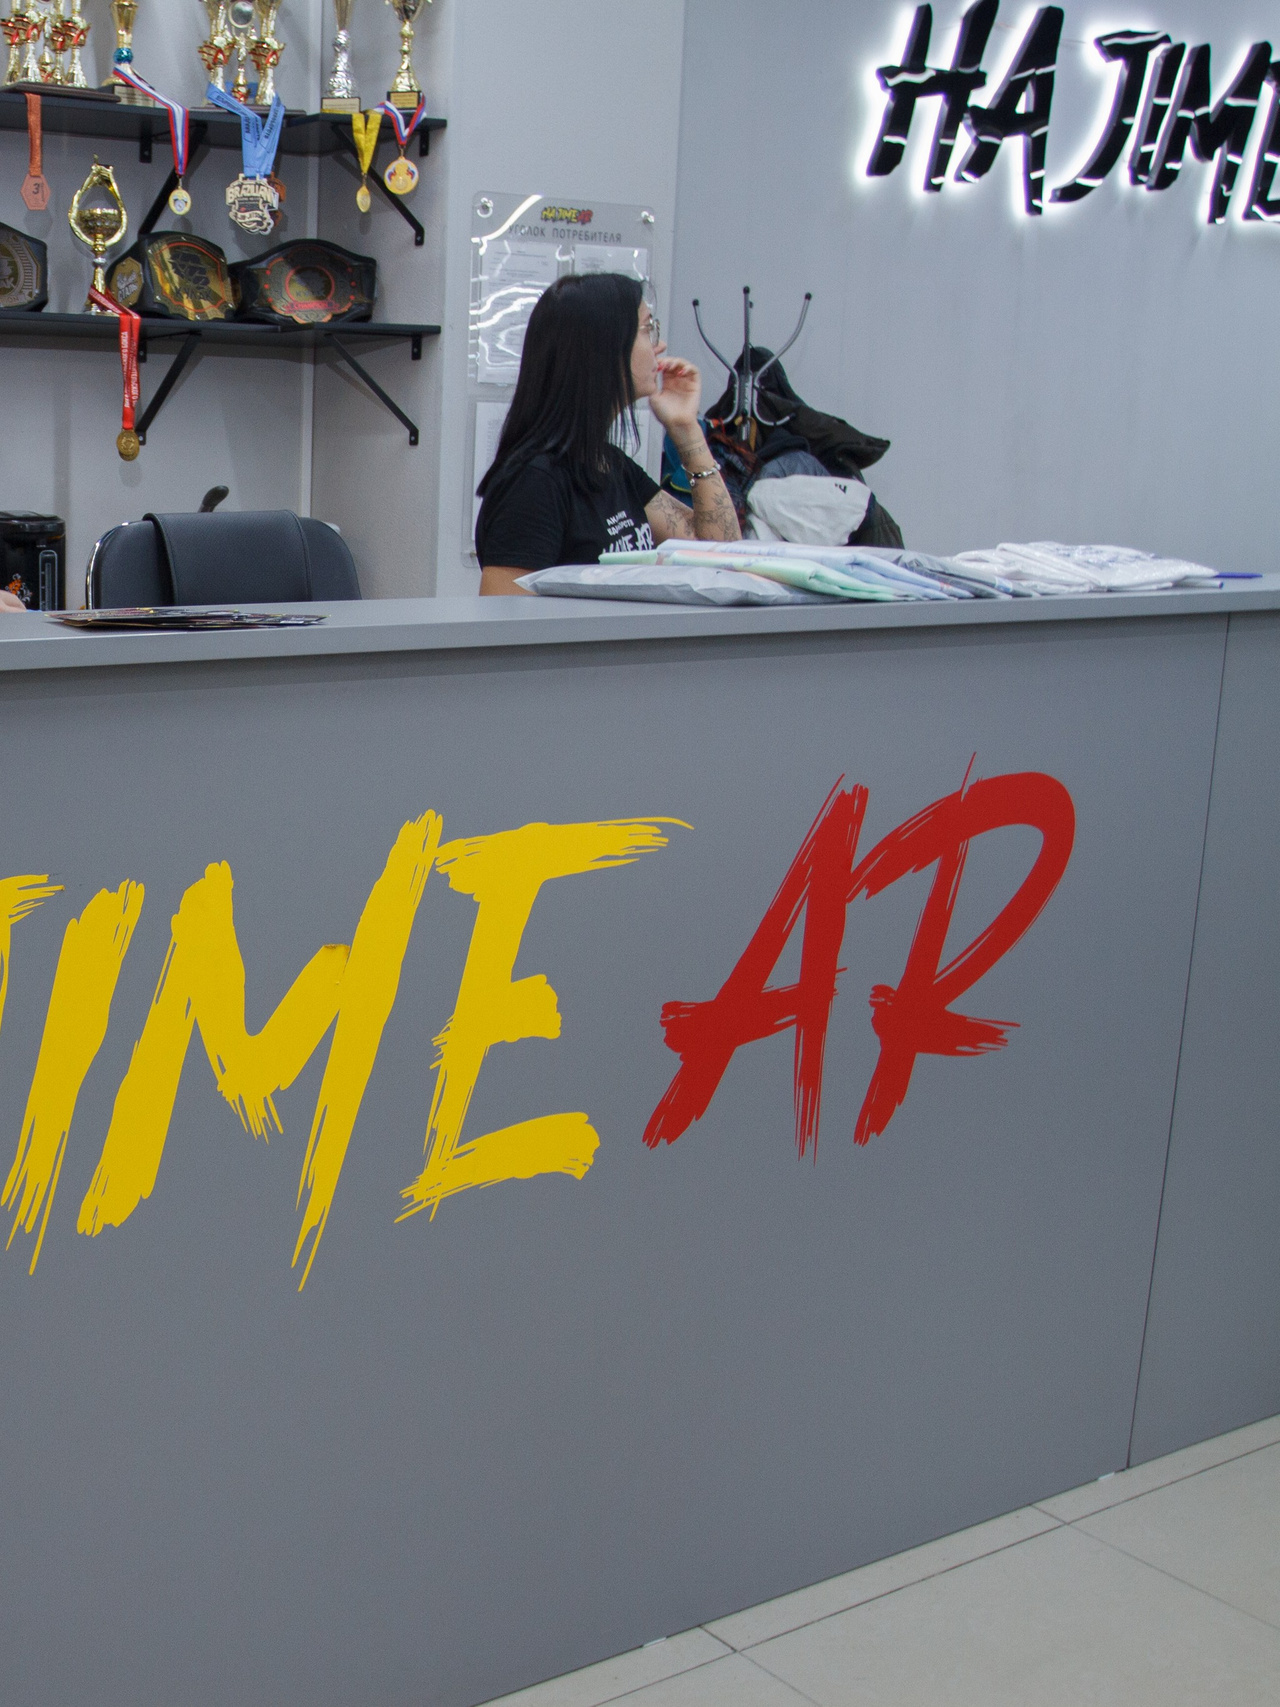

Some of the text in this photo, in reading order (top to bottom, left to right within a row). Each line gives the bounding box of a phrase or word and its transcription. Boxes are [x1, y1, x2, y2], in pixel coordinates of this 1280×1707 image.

[32, 183, 40, 195] 3
[552, 228, 622, 244] ПОТРЕБИТЕЛЯ
[643, 754, 1076, 1163] AR
